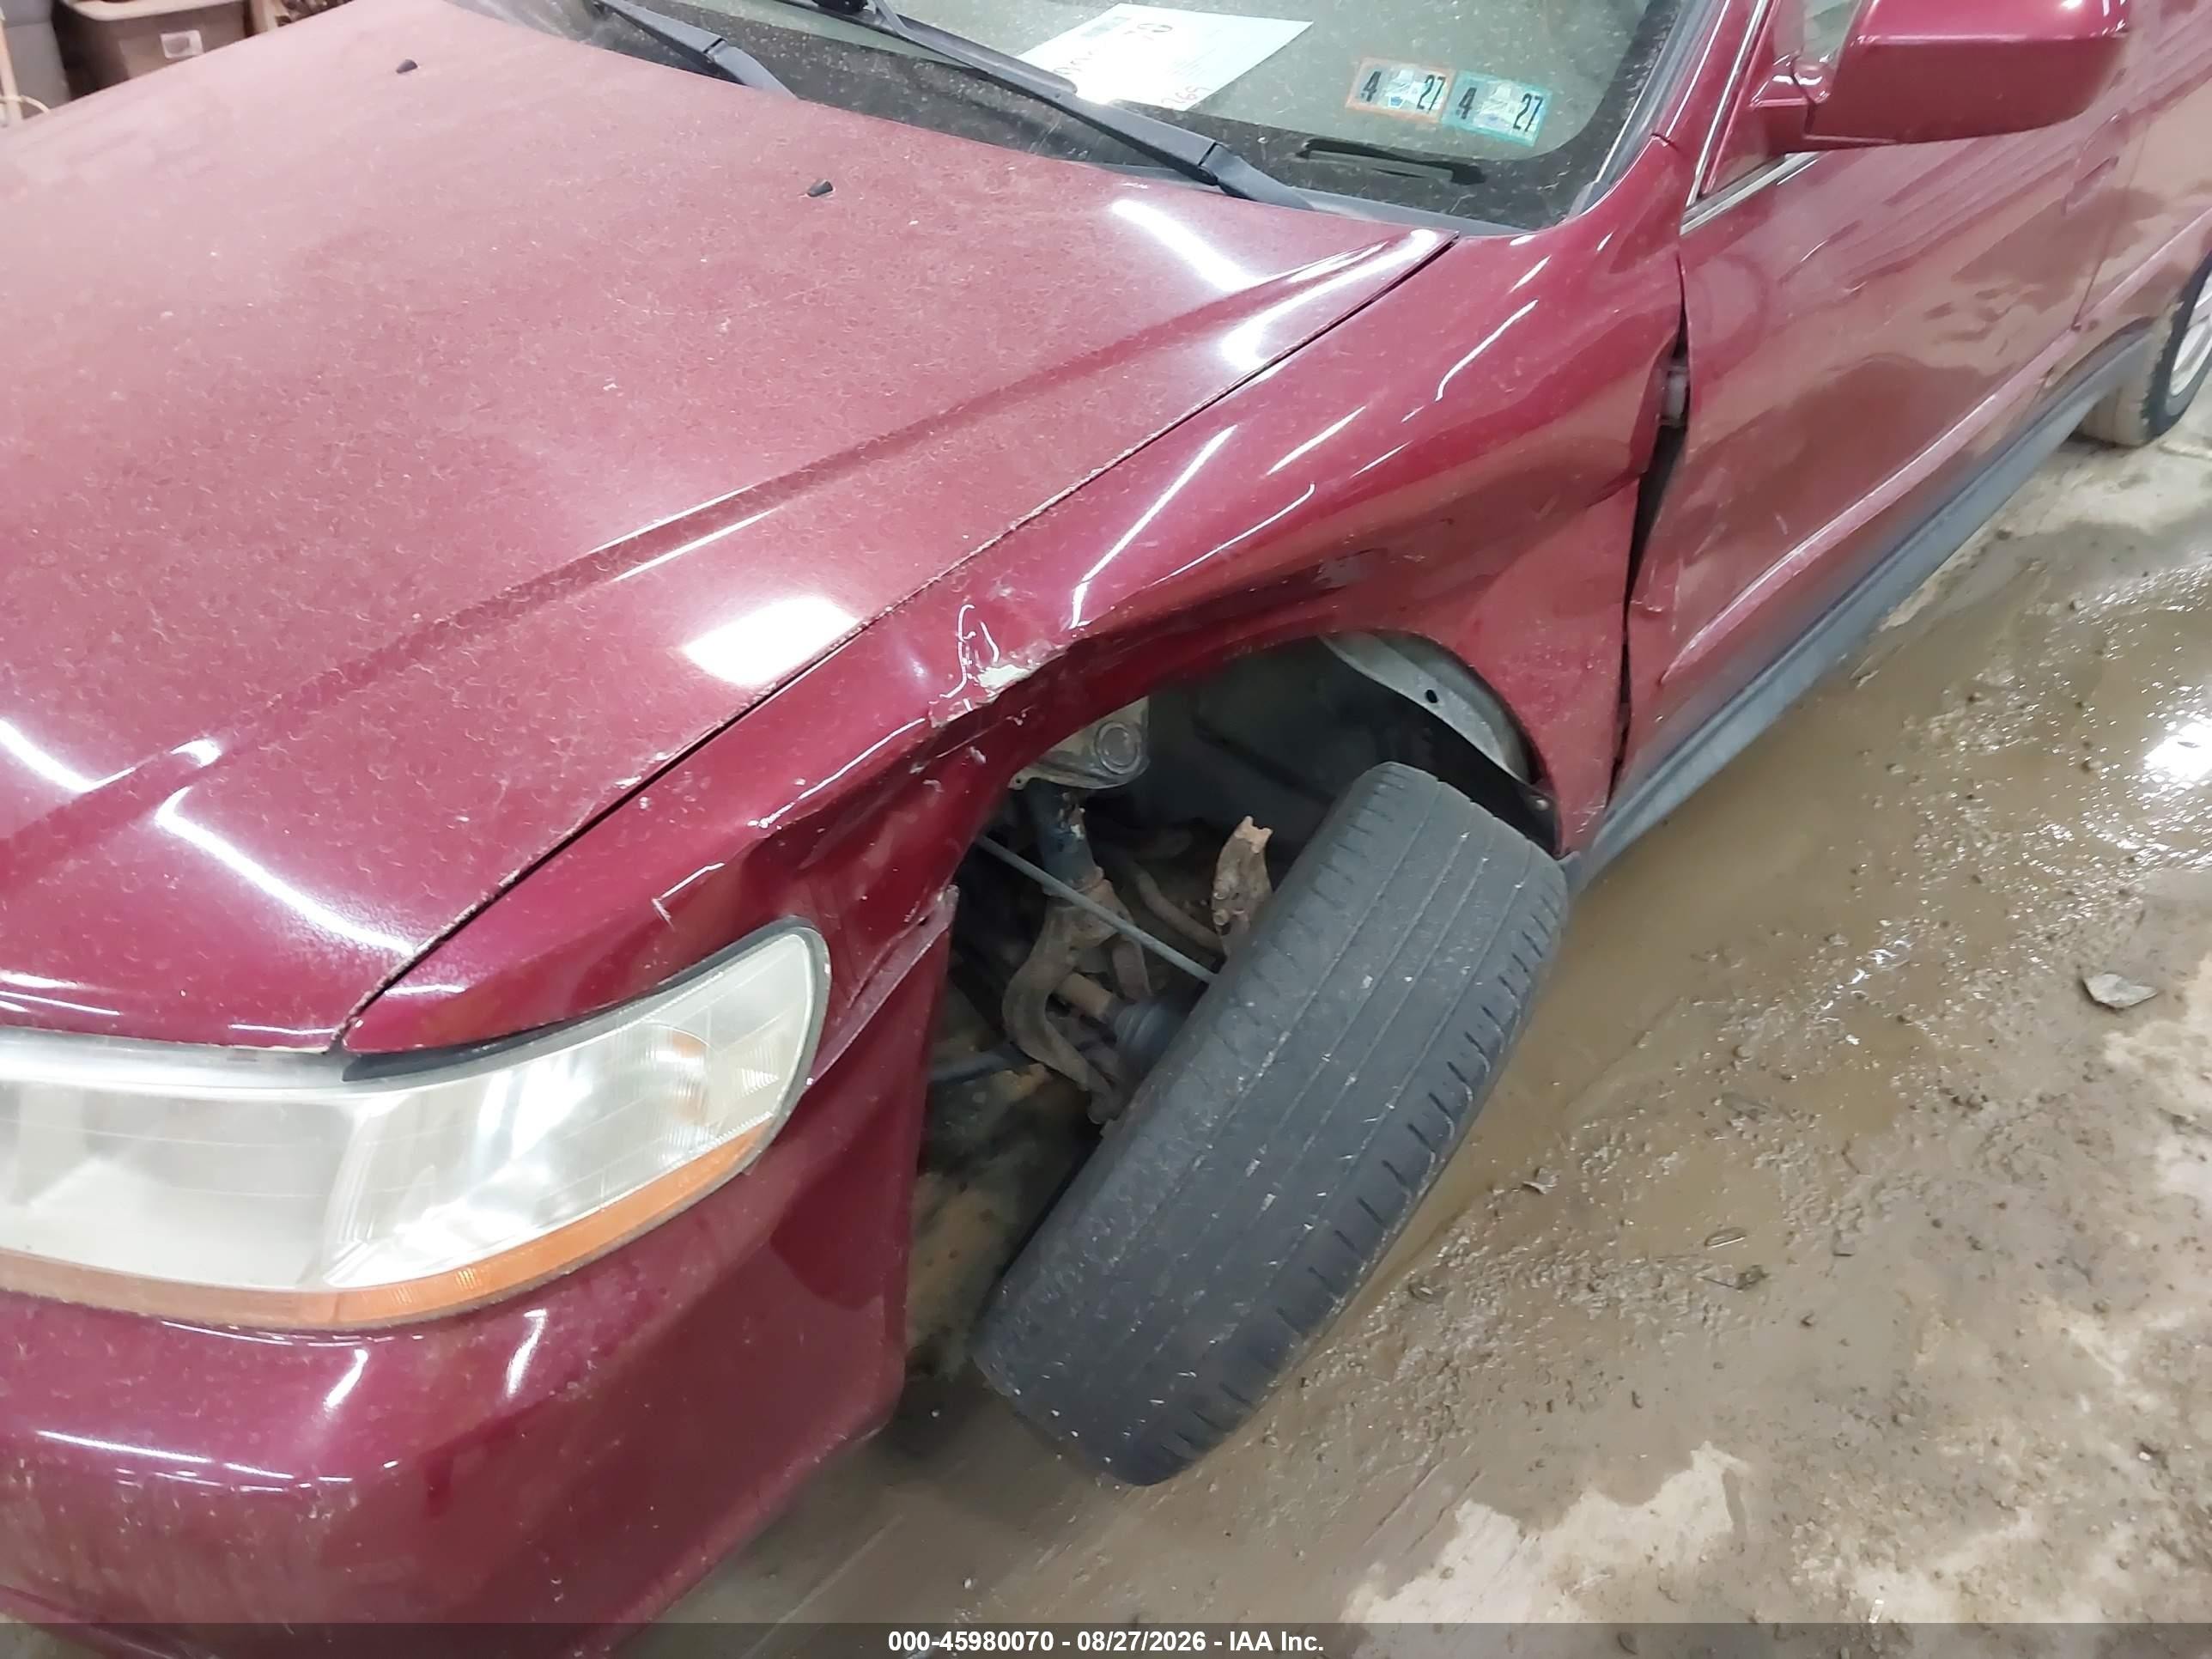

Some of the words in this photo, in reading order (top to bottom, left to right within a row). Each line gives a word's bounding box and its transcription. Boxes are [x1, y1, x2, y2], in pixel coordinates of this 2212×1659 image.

[1360, 70, 1382, 102] 4
[1417, 75, 1446, 112] 27
[1455, 87, 1478, 120] 4
[1512, 93, 1543, 131] 27
